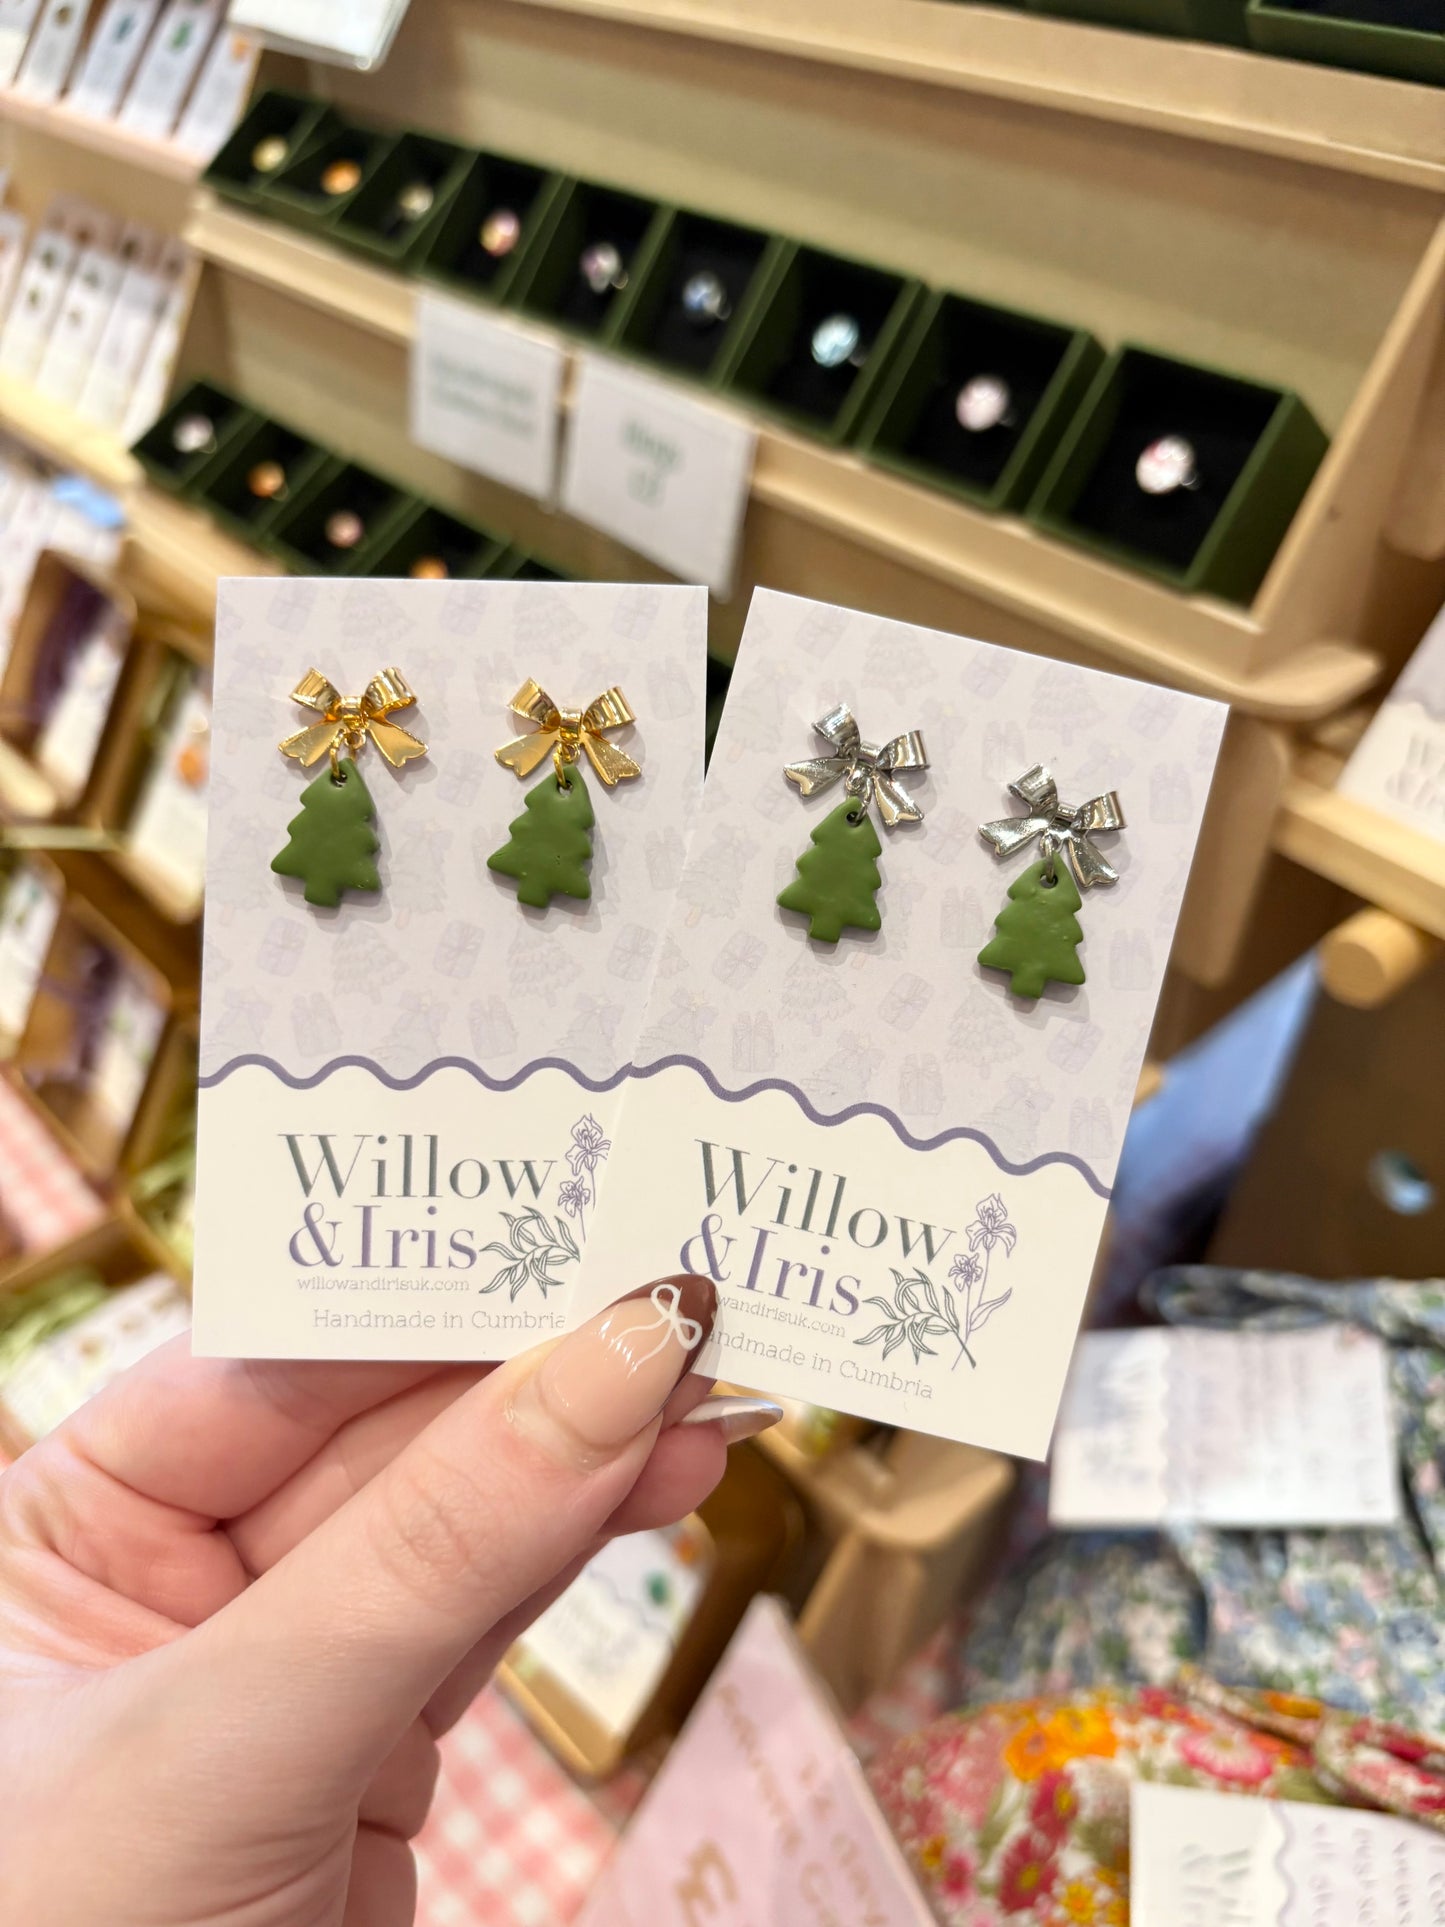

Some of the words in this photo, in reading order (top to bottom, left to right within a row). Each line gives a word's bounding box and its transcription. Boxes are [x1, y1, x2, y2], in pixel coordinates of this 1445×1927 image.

[278, 1133, 558, 1199] Willow
[694, 1138, 957, 1266] Willow
[297, 1276, 470, 1292] willowandirisuk.com
[313, 1309, 436, 1329] Handmade
[443, 1311, 463, 1329] in
[471, 1310, 566, 1329] Cumbria
[718, 1296, 846, 1338] wandirisuk.com
[811, 1352, 832, 1374] in
[839, 1358, 934, 1399] Cumbria
